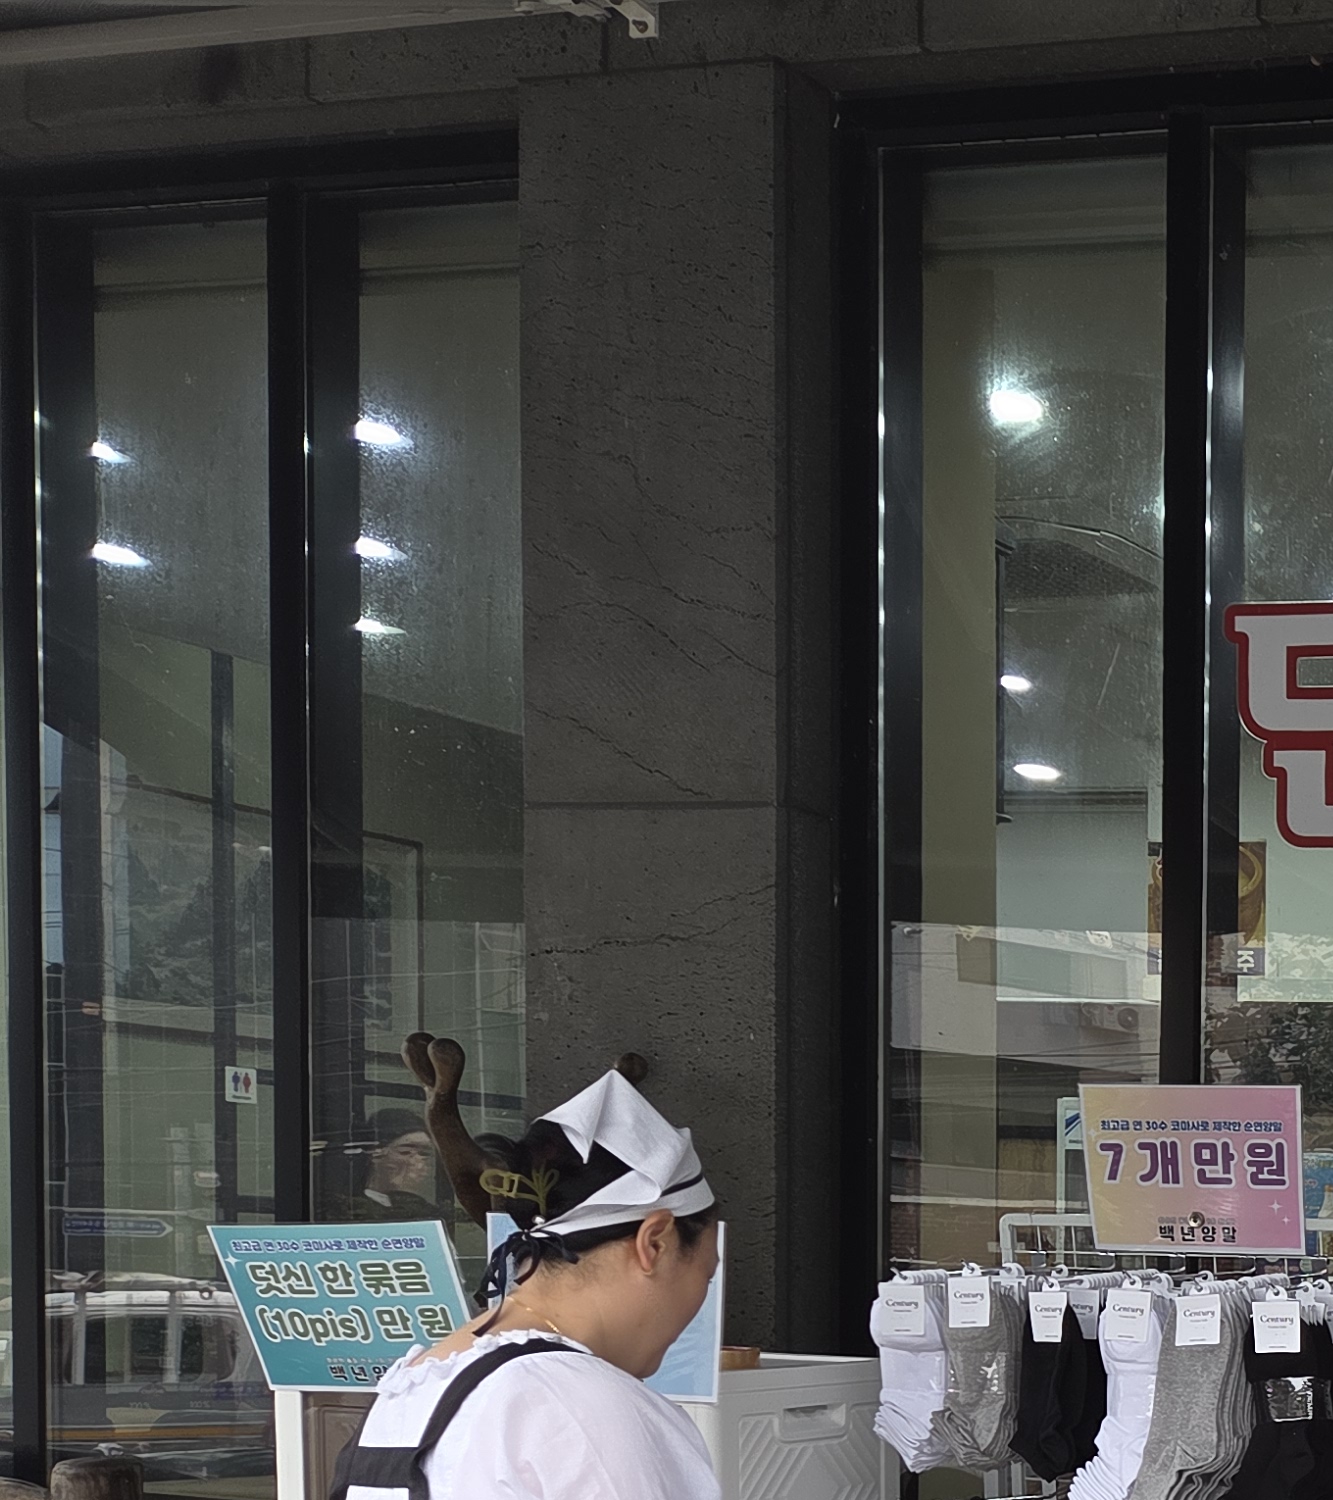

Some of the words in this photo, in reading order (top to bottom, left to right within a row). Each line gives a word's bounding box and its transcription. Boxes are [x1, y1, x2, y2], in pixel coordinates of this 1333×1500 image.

[248, 1261, 317, 1297] 덧신
[315, 1260, 356, 1296] 한
[359, 1259, 432, 1296] 묶음
[255, 1306, 371, 1344] (10pis)
[1259, 1314, 1294, 1326] Century
[328, 1365, 389, 1383] 백년양
